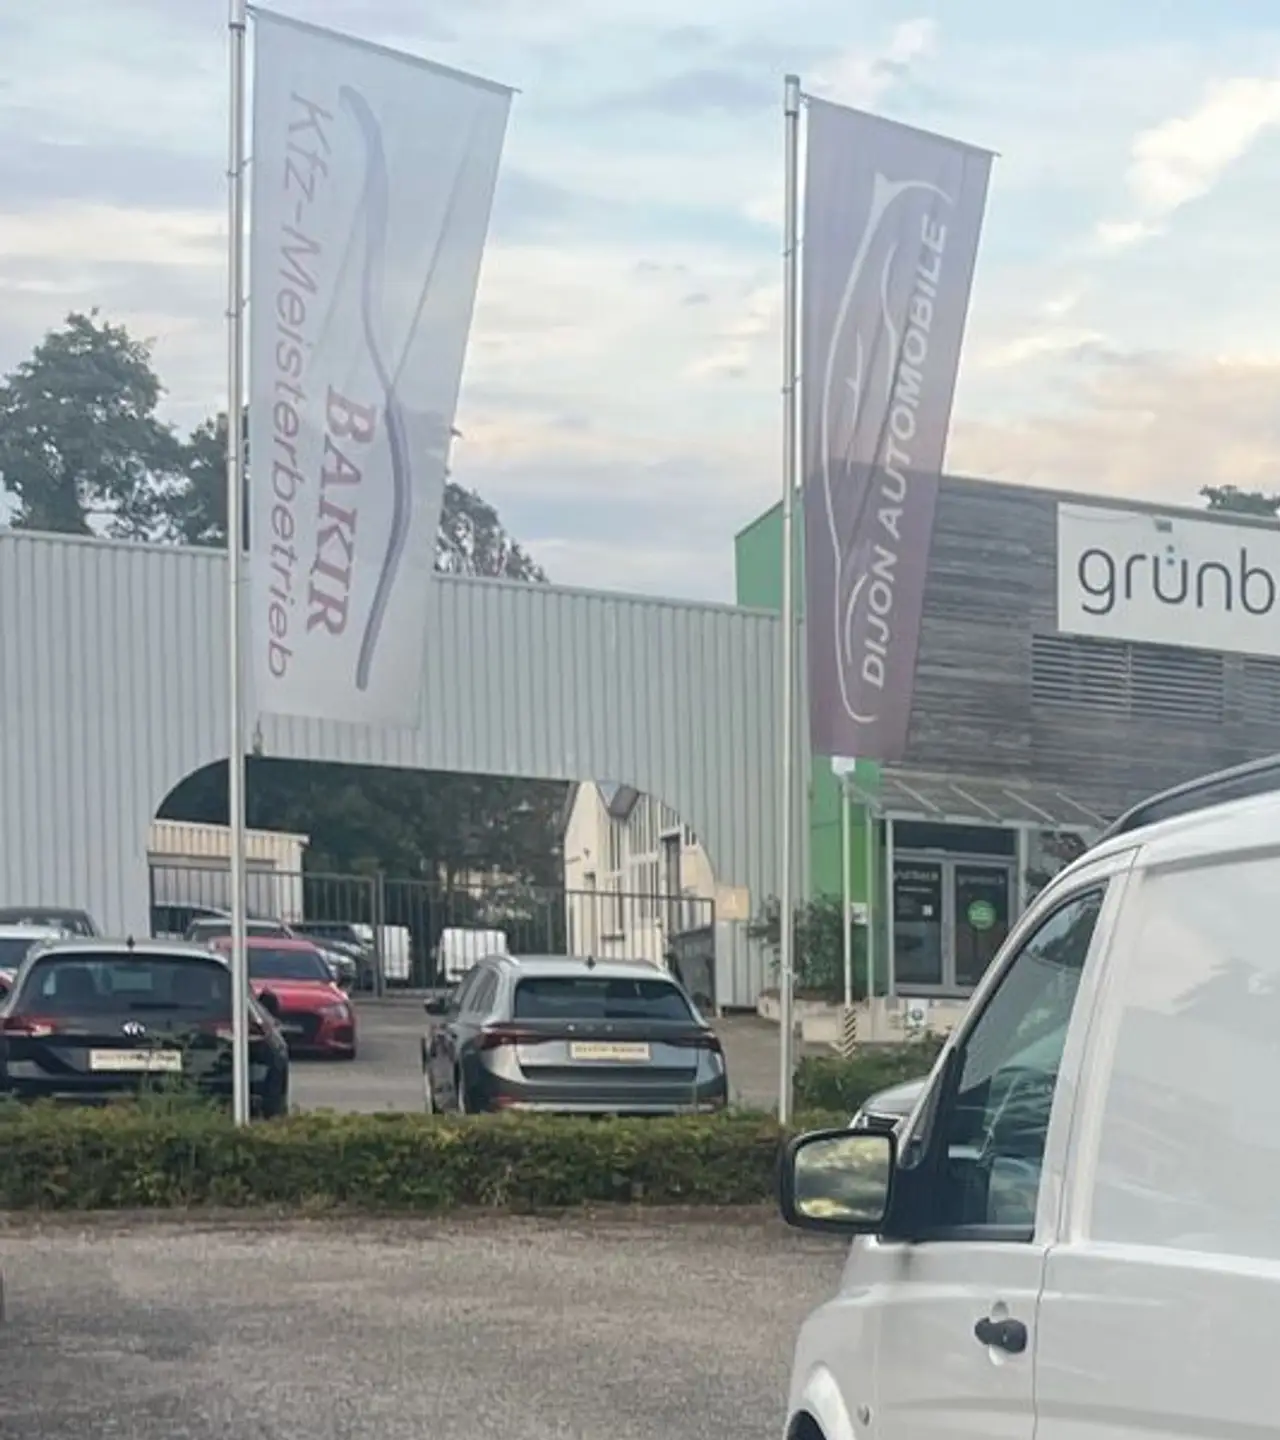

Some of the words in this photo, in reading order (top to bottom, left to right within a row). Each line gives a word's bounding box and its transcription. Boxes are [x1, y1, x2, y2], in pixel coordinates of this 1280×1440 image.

[266, 90, 334, 681] Kfz-Meisterbetrieb
[306, 384, 376, 636] BAKIR
[862, 546, 897, 689] DIJON
[881, 213, 947, 540] AUTOMOBILE
